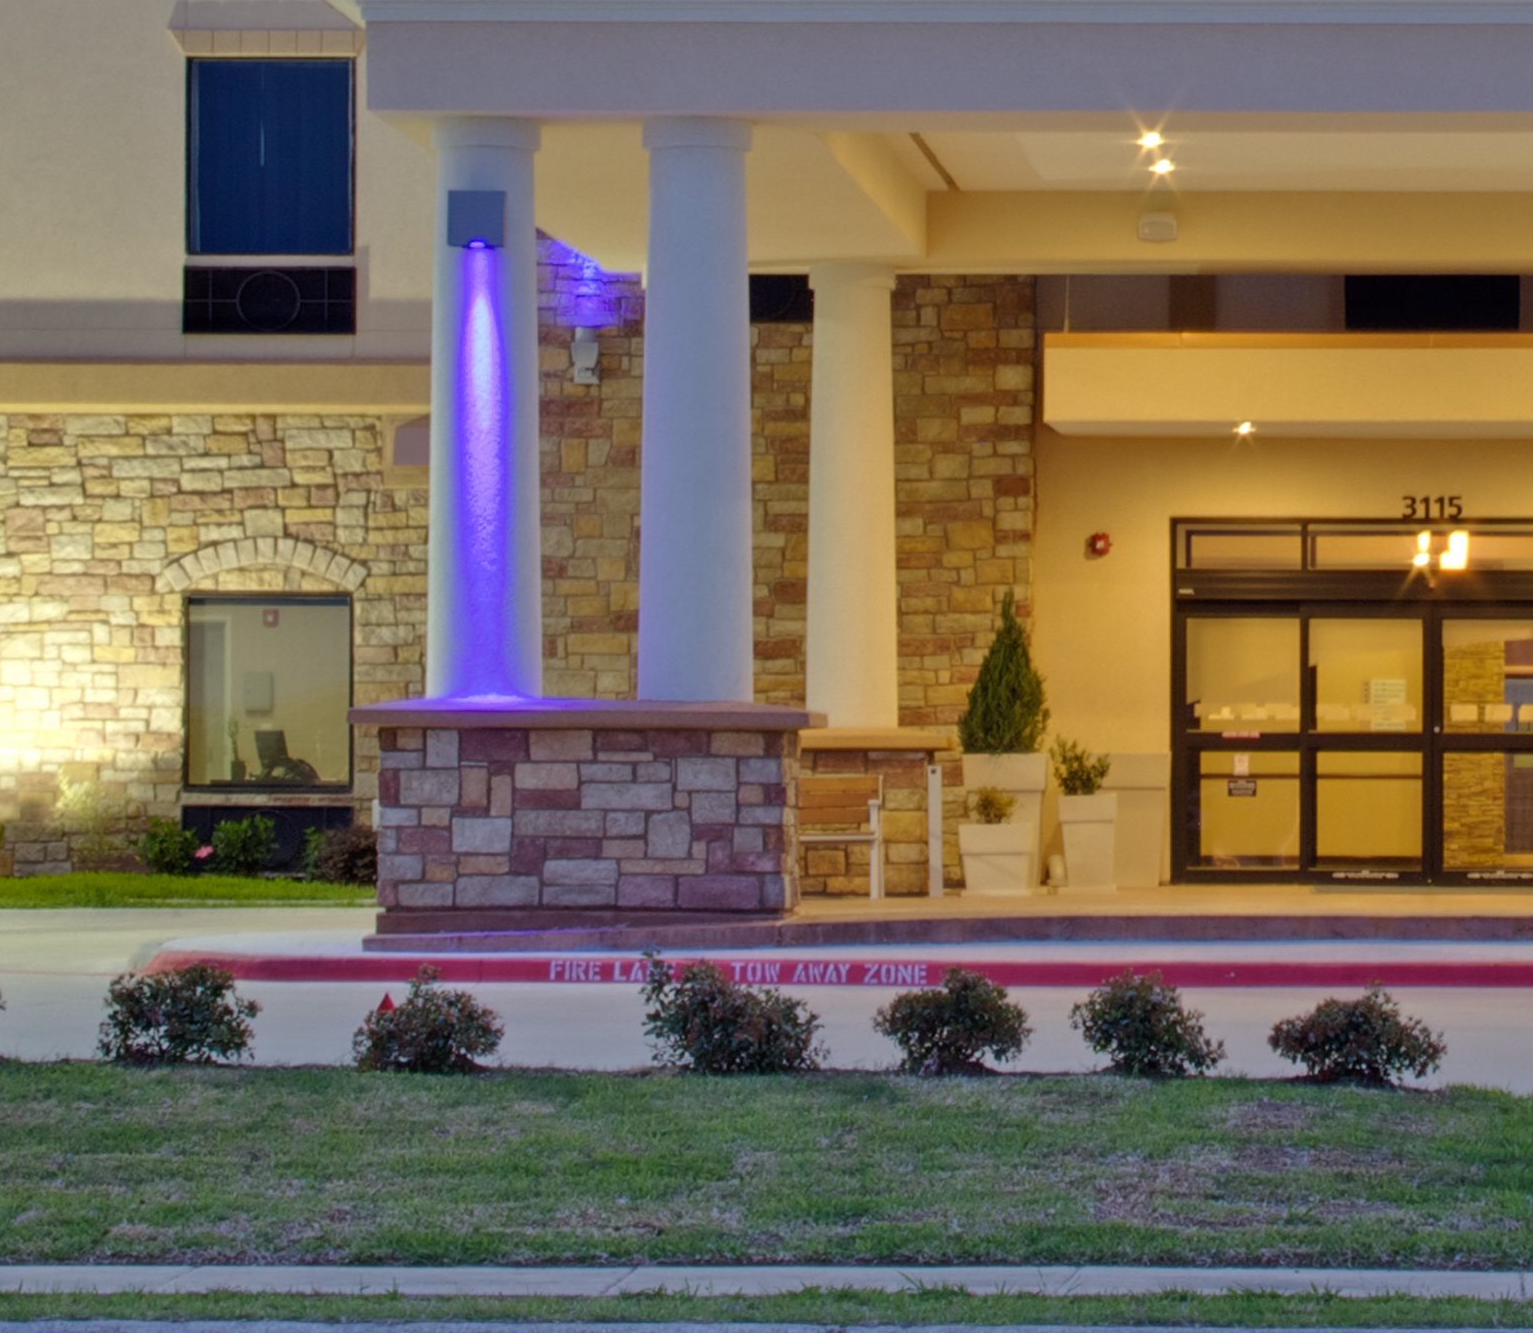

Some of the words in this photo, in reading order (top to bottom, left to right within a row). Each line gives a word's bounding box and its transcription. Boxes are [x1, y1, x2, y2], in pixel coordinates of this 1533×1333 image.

[1402, 496, 1463, 520] 3115
[550, 960, 602, 981] FIRE
[731, 962, 781, 983] TOW
[792, 962, 851, 983] AWAY
[864, 964, 927, 984] ZONE
